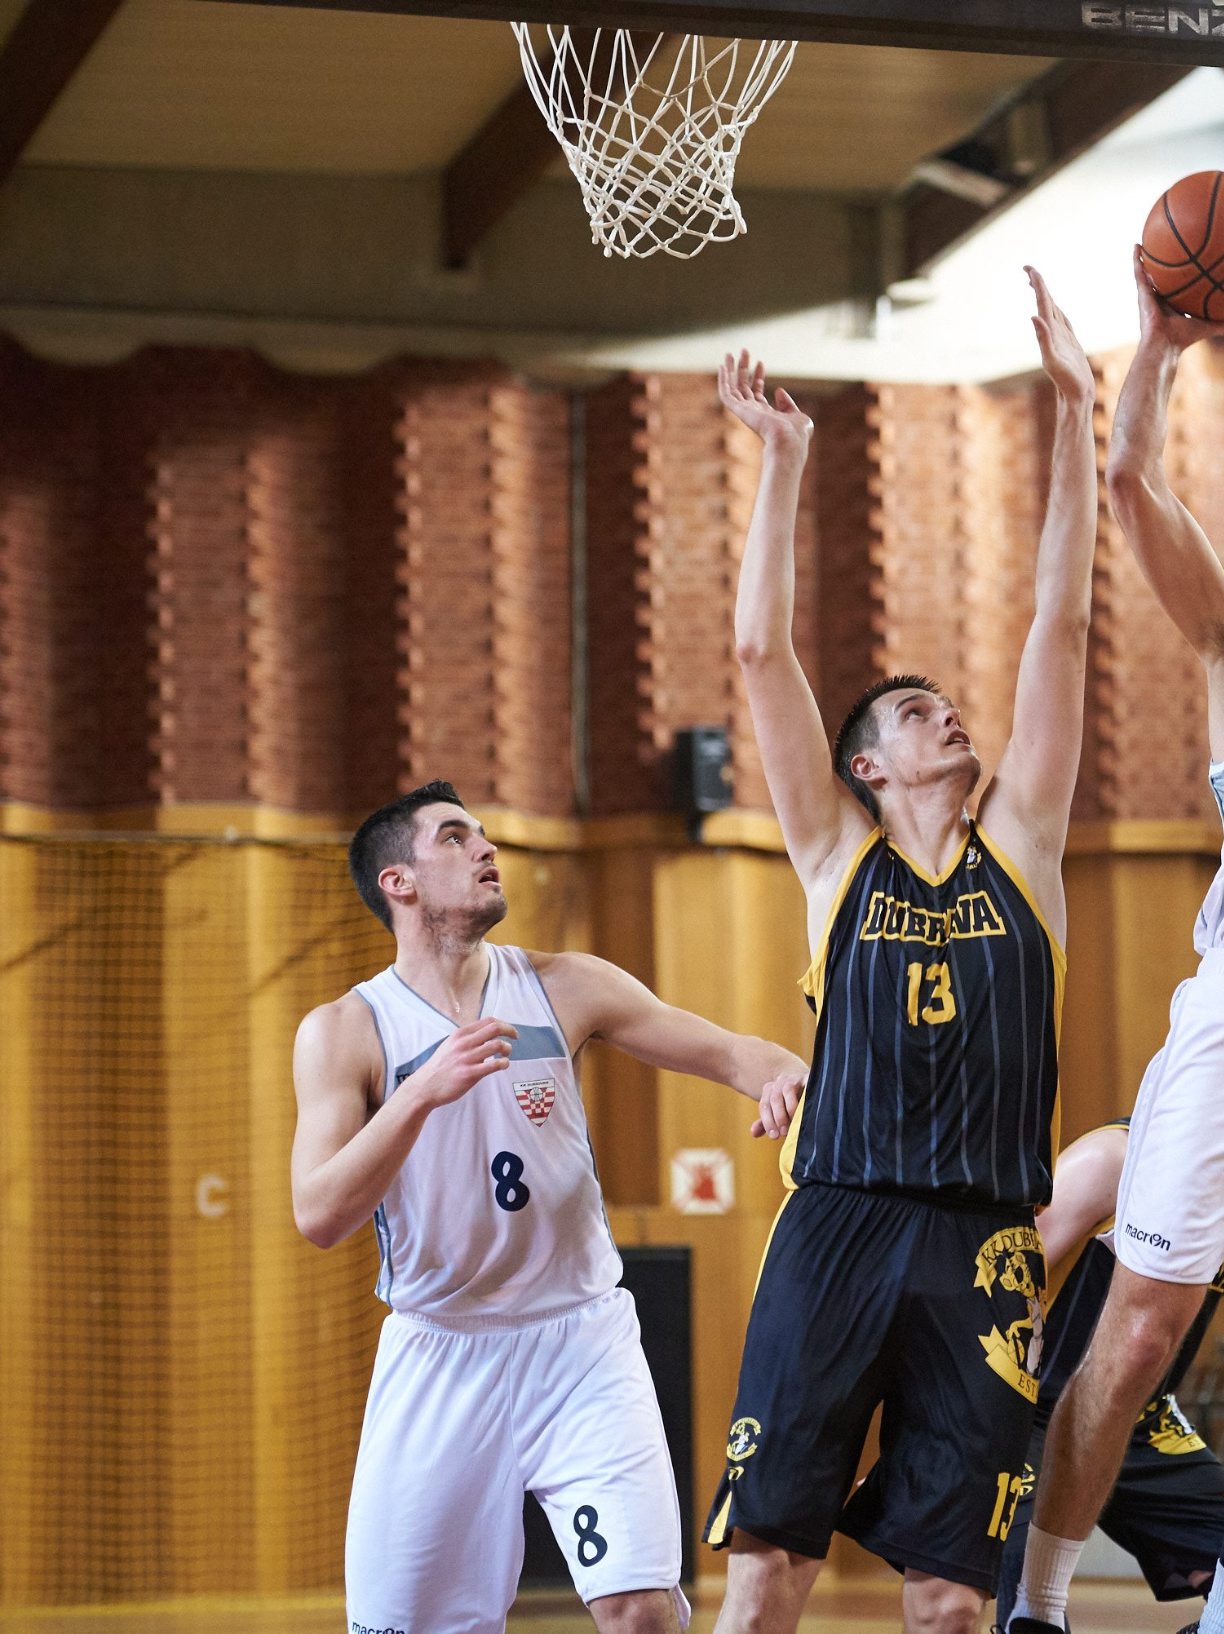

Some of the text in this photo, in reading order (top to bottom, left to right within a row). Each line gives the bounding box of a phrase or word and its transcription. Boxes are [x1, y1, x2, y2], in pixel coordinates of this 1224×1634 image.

[907, 961, 957, 1026] 13
[491, 1151, 530, 1212] 8
[1125, 1223, 1171, 1251] macron
[573, 1505, 608, 1567] 8
